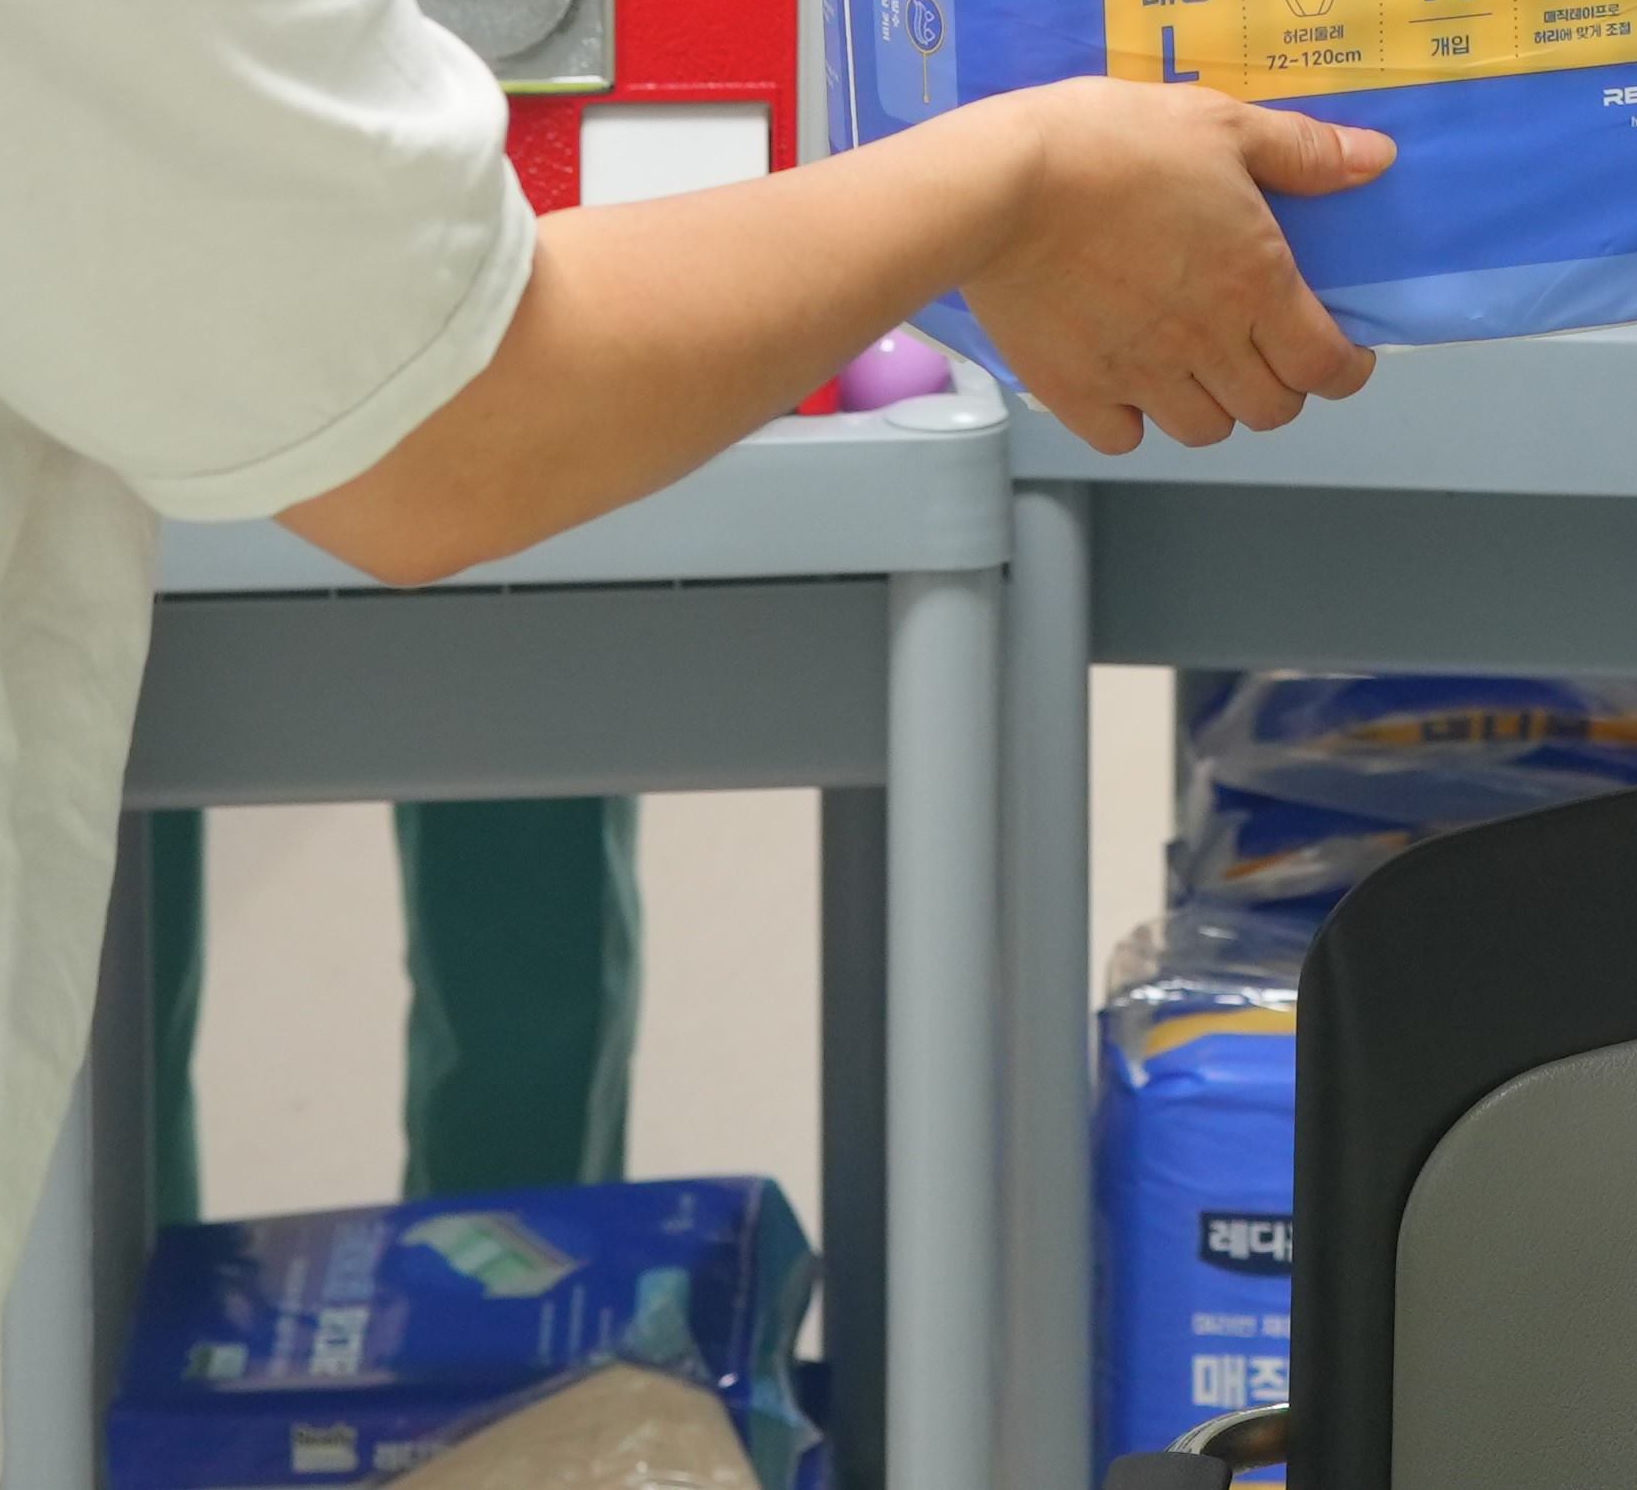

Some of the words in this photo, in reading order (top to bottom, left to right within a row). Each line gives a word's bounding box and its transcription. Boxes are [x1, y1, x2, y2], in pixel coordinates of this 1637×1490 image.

[1543, 3, 1620, 24] 매직테이프로
[1282, 24, 1345, 45] 허리둘레
[1533, 28, 1573, 45] 허리에
[1576, 24, 1602, 40] 맞게
[1605, 21, 1632, 37] 조절
[1161, 25, 1200, 85] L
[1430, 34, 1470, 57] 개입
[1266, 48, 1362, 71] 72~120cm
[1208, 1219, 1293, 1262] 레디
